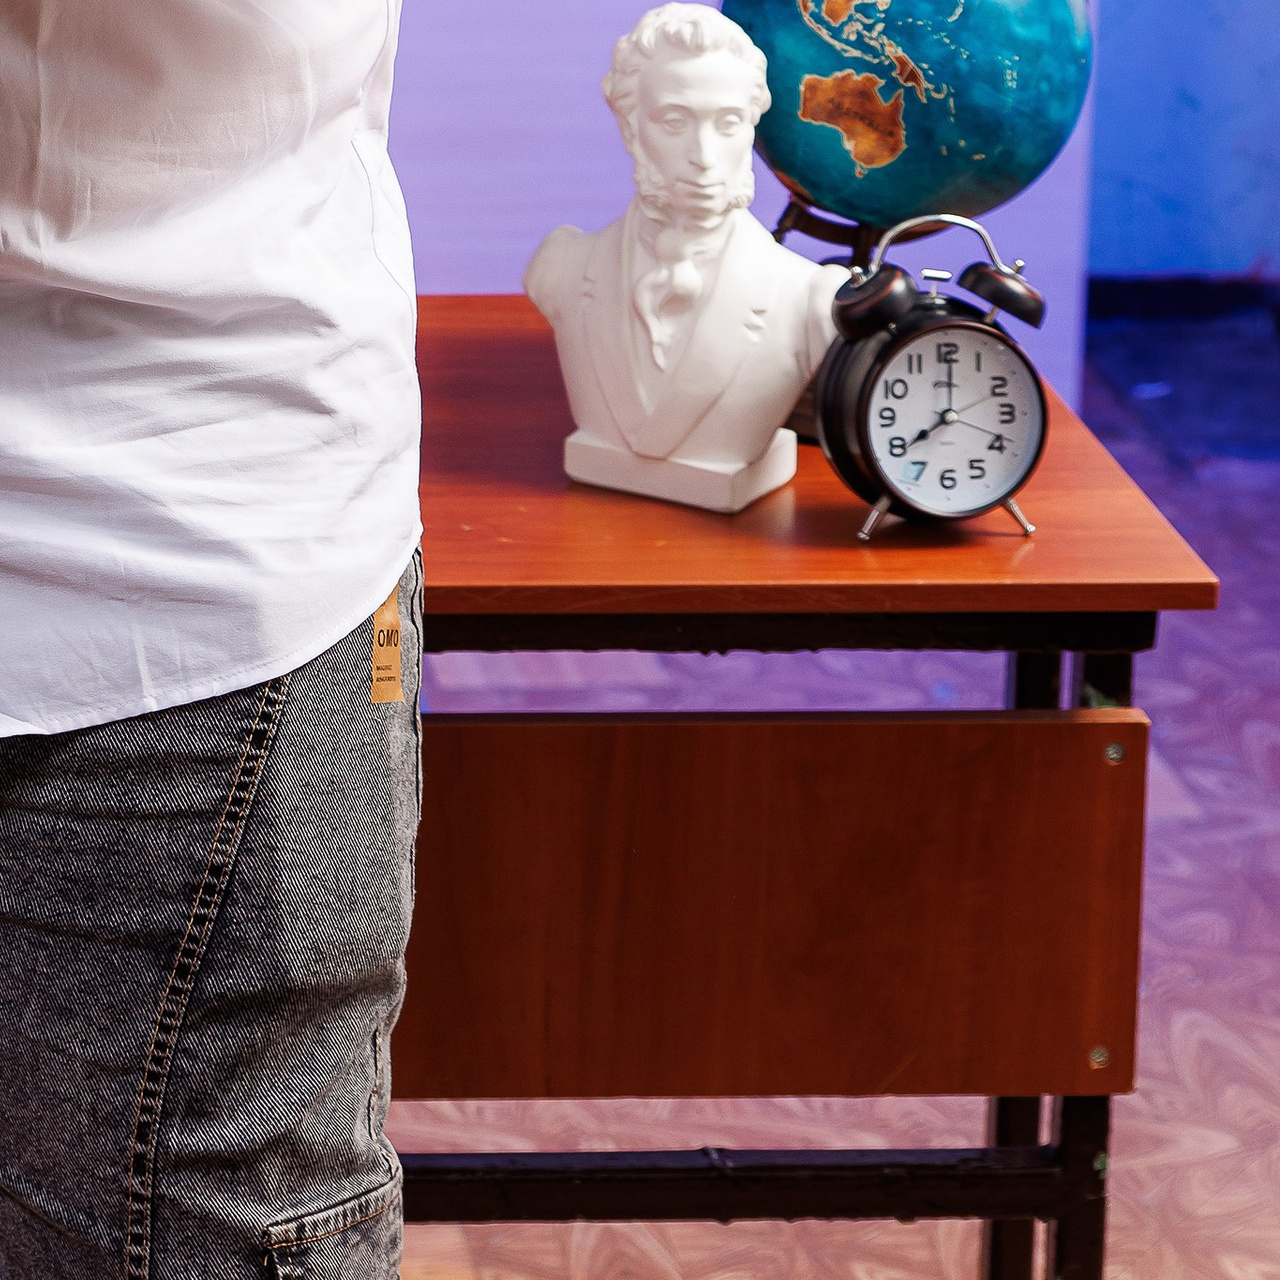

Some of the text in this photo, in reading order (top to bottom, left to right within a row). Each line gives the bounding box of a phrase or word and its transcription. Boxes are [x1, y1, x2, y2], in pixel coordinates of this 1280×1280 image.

[907, 353, 923, 374] 11
[936, 342, 960, 364] 12
[975, 351, 982, 372] 1
[884, 378, 909, 399] 10
[991, 376, 1008, 397] 2
[879, 407, 896, 428] 9
[999, 403, 1015, 424] 3
[889, 436, 907, 458] 8
[987, 434, 1007, 455] 4
[911, 460, 928, 482] 7
[940, 469, 957, 490] 6
[969, 459, 986, 479] 5
[377, 629, 399, 648] OMO
